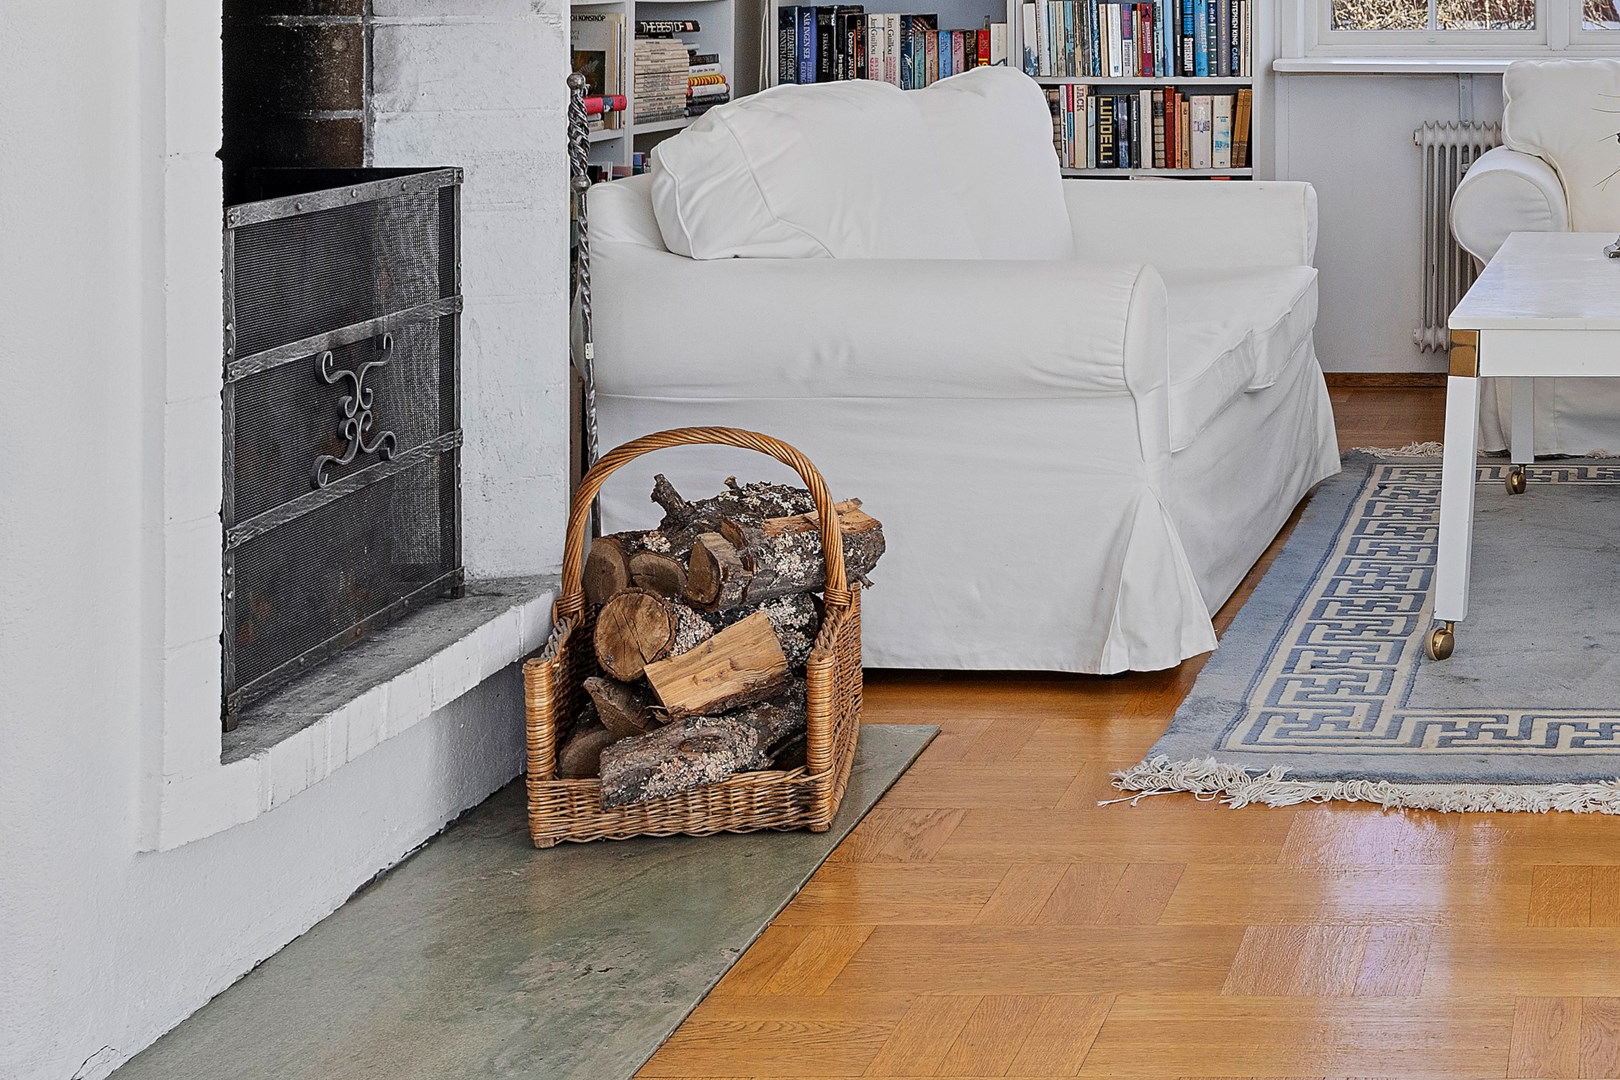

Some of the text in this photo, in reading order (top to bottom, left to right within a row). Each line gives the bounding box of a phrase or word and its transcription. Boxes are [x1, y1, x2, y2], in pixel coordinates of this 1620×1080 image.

[642, 21, 684, 32] THE BEST OF
[870, 17, 878, 54] Jan Guillou
[1184, 0, 1194, 71] COLIN FORBES SYSTERSKAPET
[1076, 87, 1084, 111] JACK
[1100, 98, 1112, 160] LUNDELL
